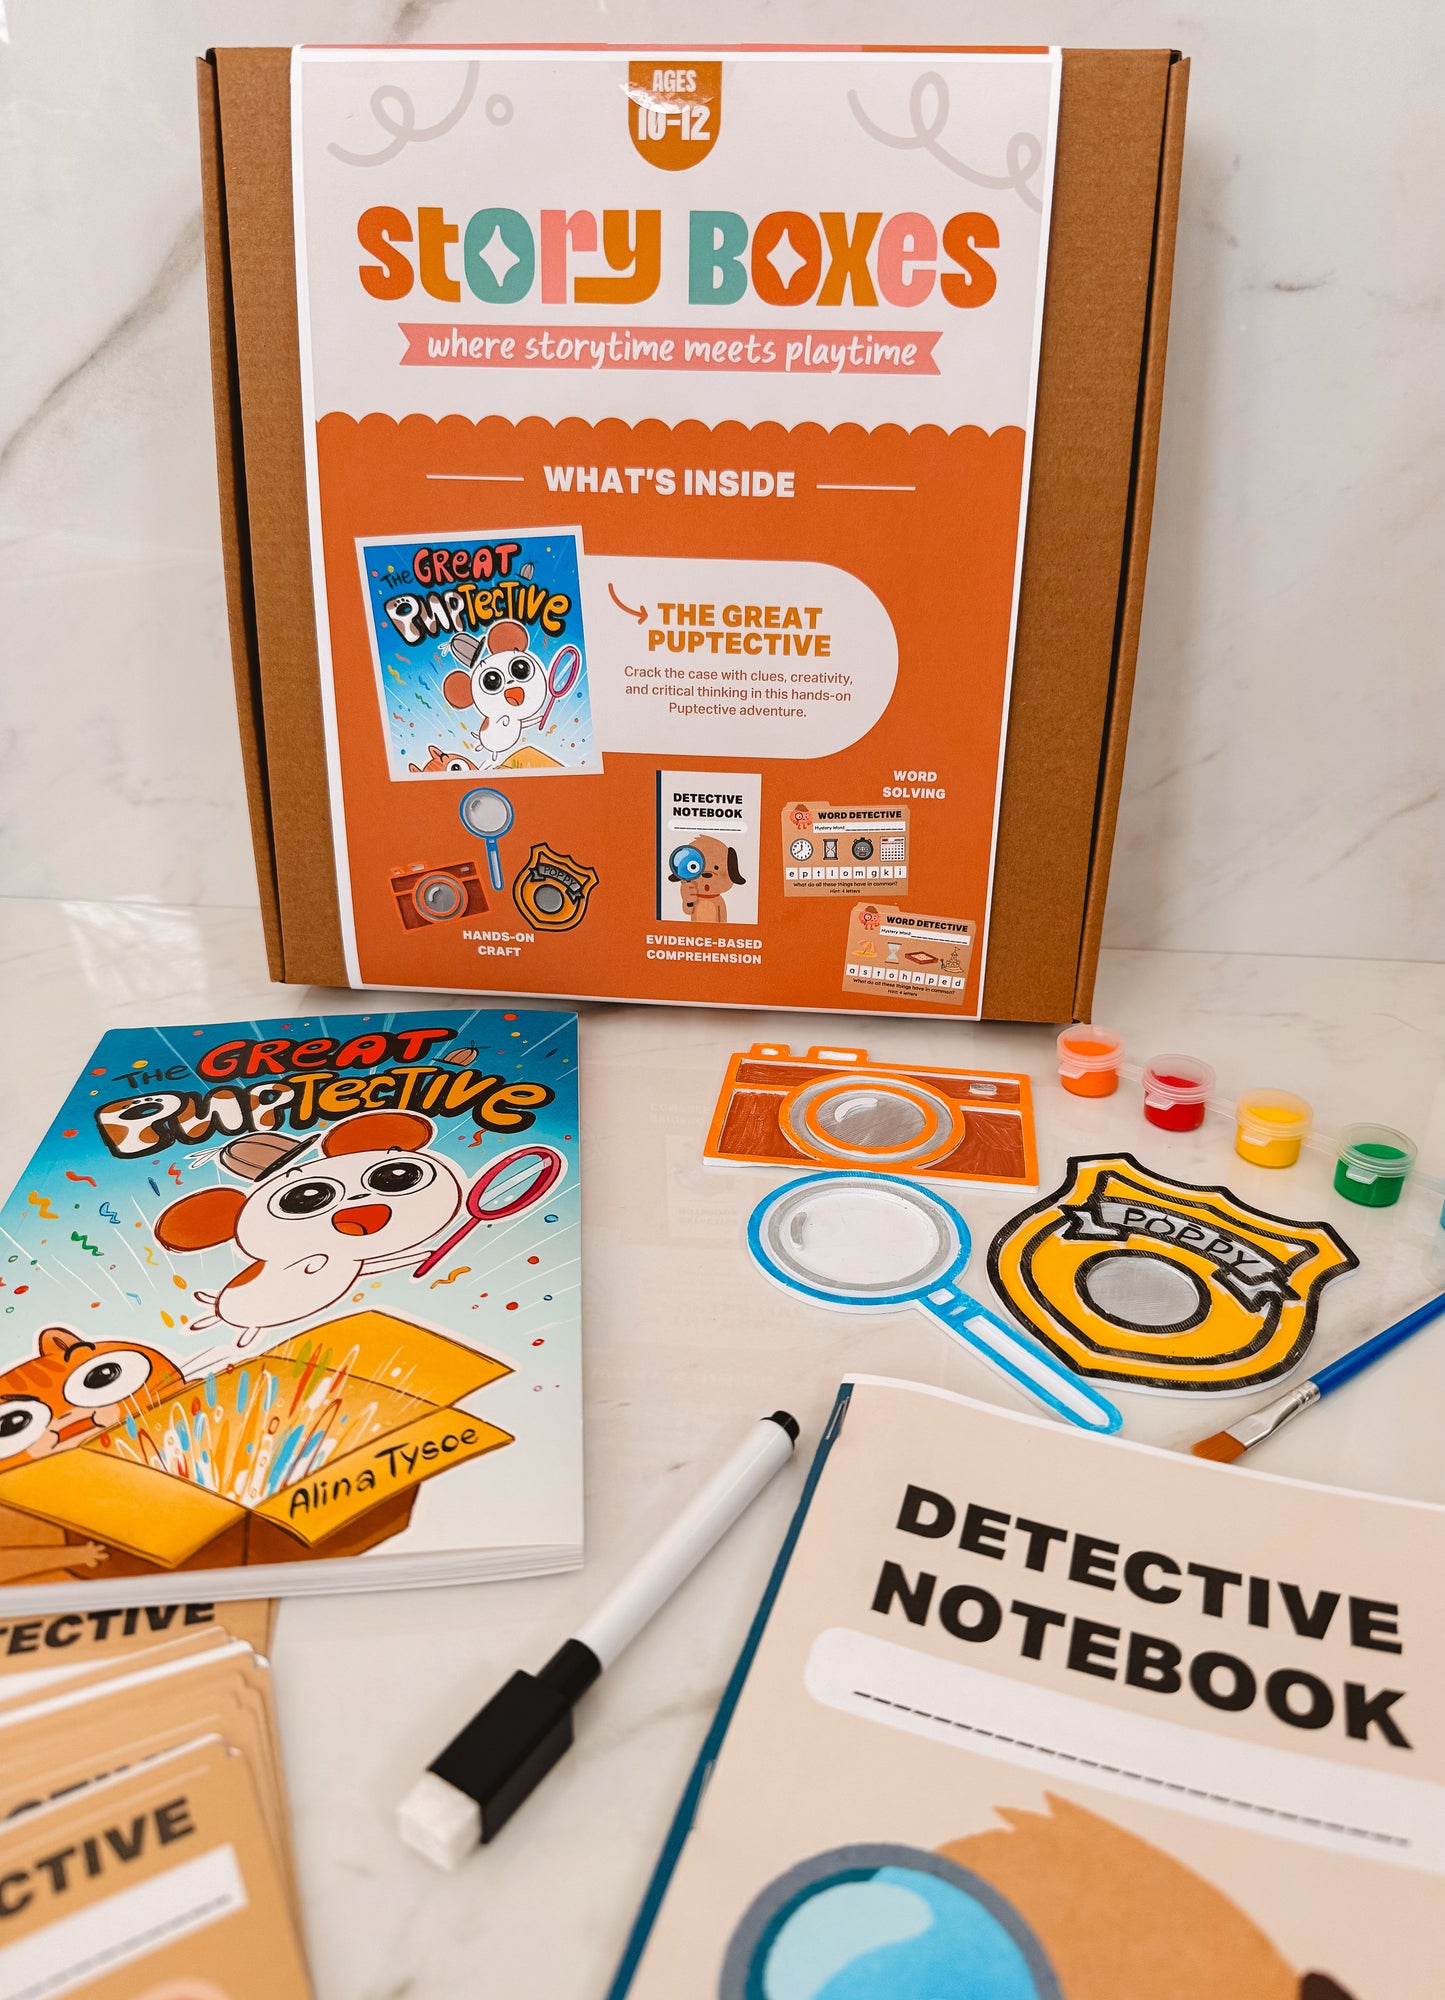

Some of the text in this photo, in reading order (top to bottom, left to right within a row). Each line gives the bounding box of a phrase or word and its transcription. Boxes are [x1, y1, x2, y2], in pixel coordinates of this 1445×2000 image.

[653, 70, 697, 92] AGES
[638, 104, 710, 140] 10-12
[427, 328, 917, 374] where storytime meets playtime
[543, 466, 796, 498] WHAT'S INSIDE
[657, 603, 823, 630] THE GREAT
[648, 629, 831, 657] PUPTECTIVE
[624, 665, 853, 686] Crack the case with clues, creativity,
[625, 684, 851, 701] and critical thinking in this hands-on
[669, 702, 807, 718] Puptective adventure.
[893, 770, 938, 782] WORD
[673, 792, 743, 805] DETECTIVE
[882, 787, 946, 800] SOLVING
[672, 807, 743, 819] NOTEBOOK
[818, 811, 902, 820] WORD DETECTIVE
[544, 865, 577, 886] POPPY
[886, 916, 968, 933] WORD DETECTIVE
[463, 930, 535, 943] HANDS-ON
[646, 934, 763, 950] EVIDENCE-BASED
[477, 945, 521, 957] CRAFT
[646, 950, 762, 965] COMPREHENSION
[896, 983, 911, 991] things
[1123, 1207, 1260, 1267] POPPY
[289, 1428, 479, 1519] Alina Tysoe
[895, 1483, 1404, 1656] DETECTIVE
[870, 1560, 1414, 1751] NOTEBOOK
